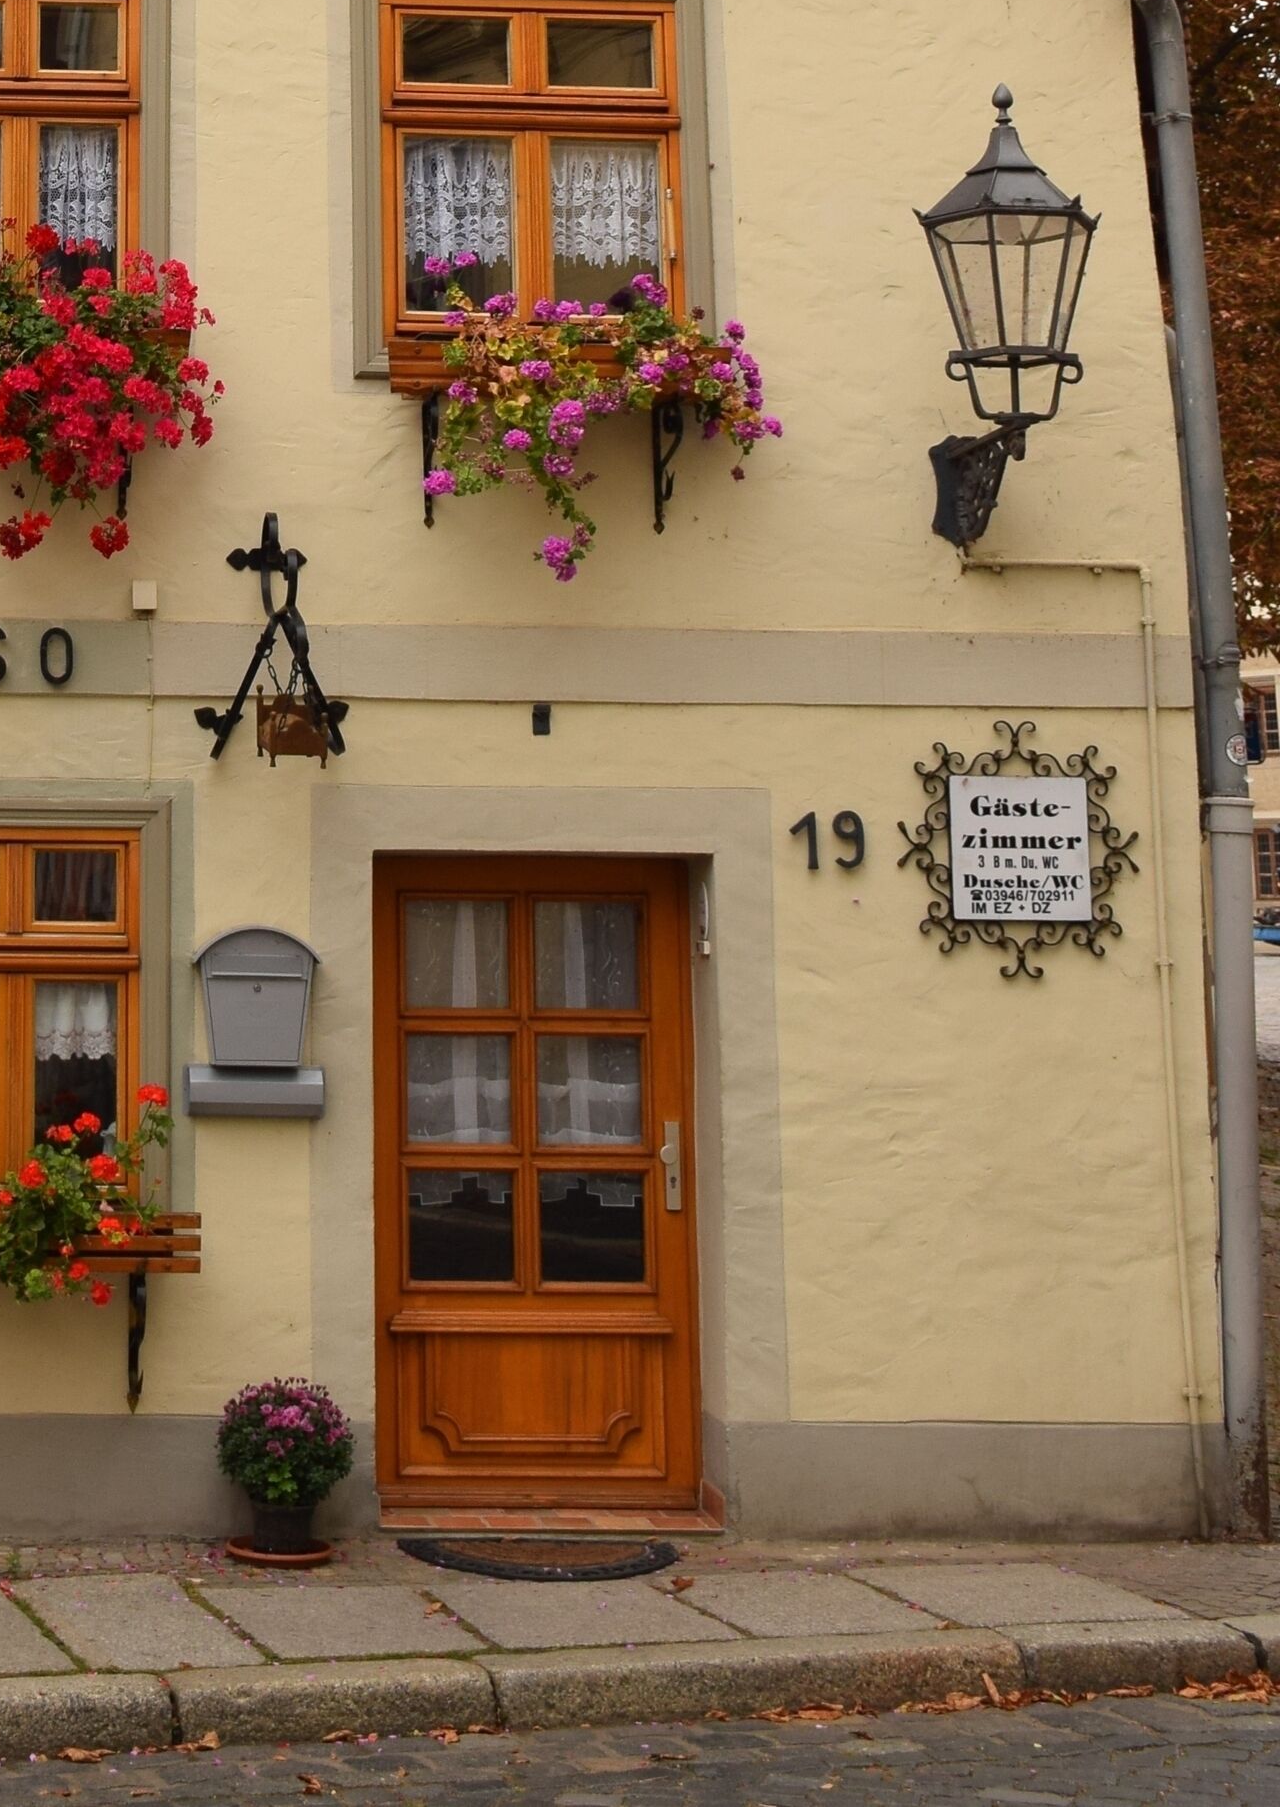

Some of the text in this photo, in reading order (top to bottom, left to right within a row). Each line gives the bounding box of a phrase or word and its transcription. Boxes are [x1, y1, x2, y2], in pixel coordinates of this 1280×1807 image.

[969, 794, 1071, 818] Gäste-
[788, 810, 865, 870] 19
[961, 827, 1083, 850] zimmer
[978, 855, 1059, 869] 3 B m. Du. WC
[963, 874, 1085, 890] Dusche/WC
[985, 890, 1075, 902] 03946/702911
[971, 902, 987, 914] IM
[993, 902, 1013, 914] EZ
[1032, 902, 1052, 914] DZ
